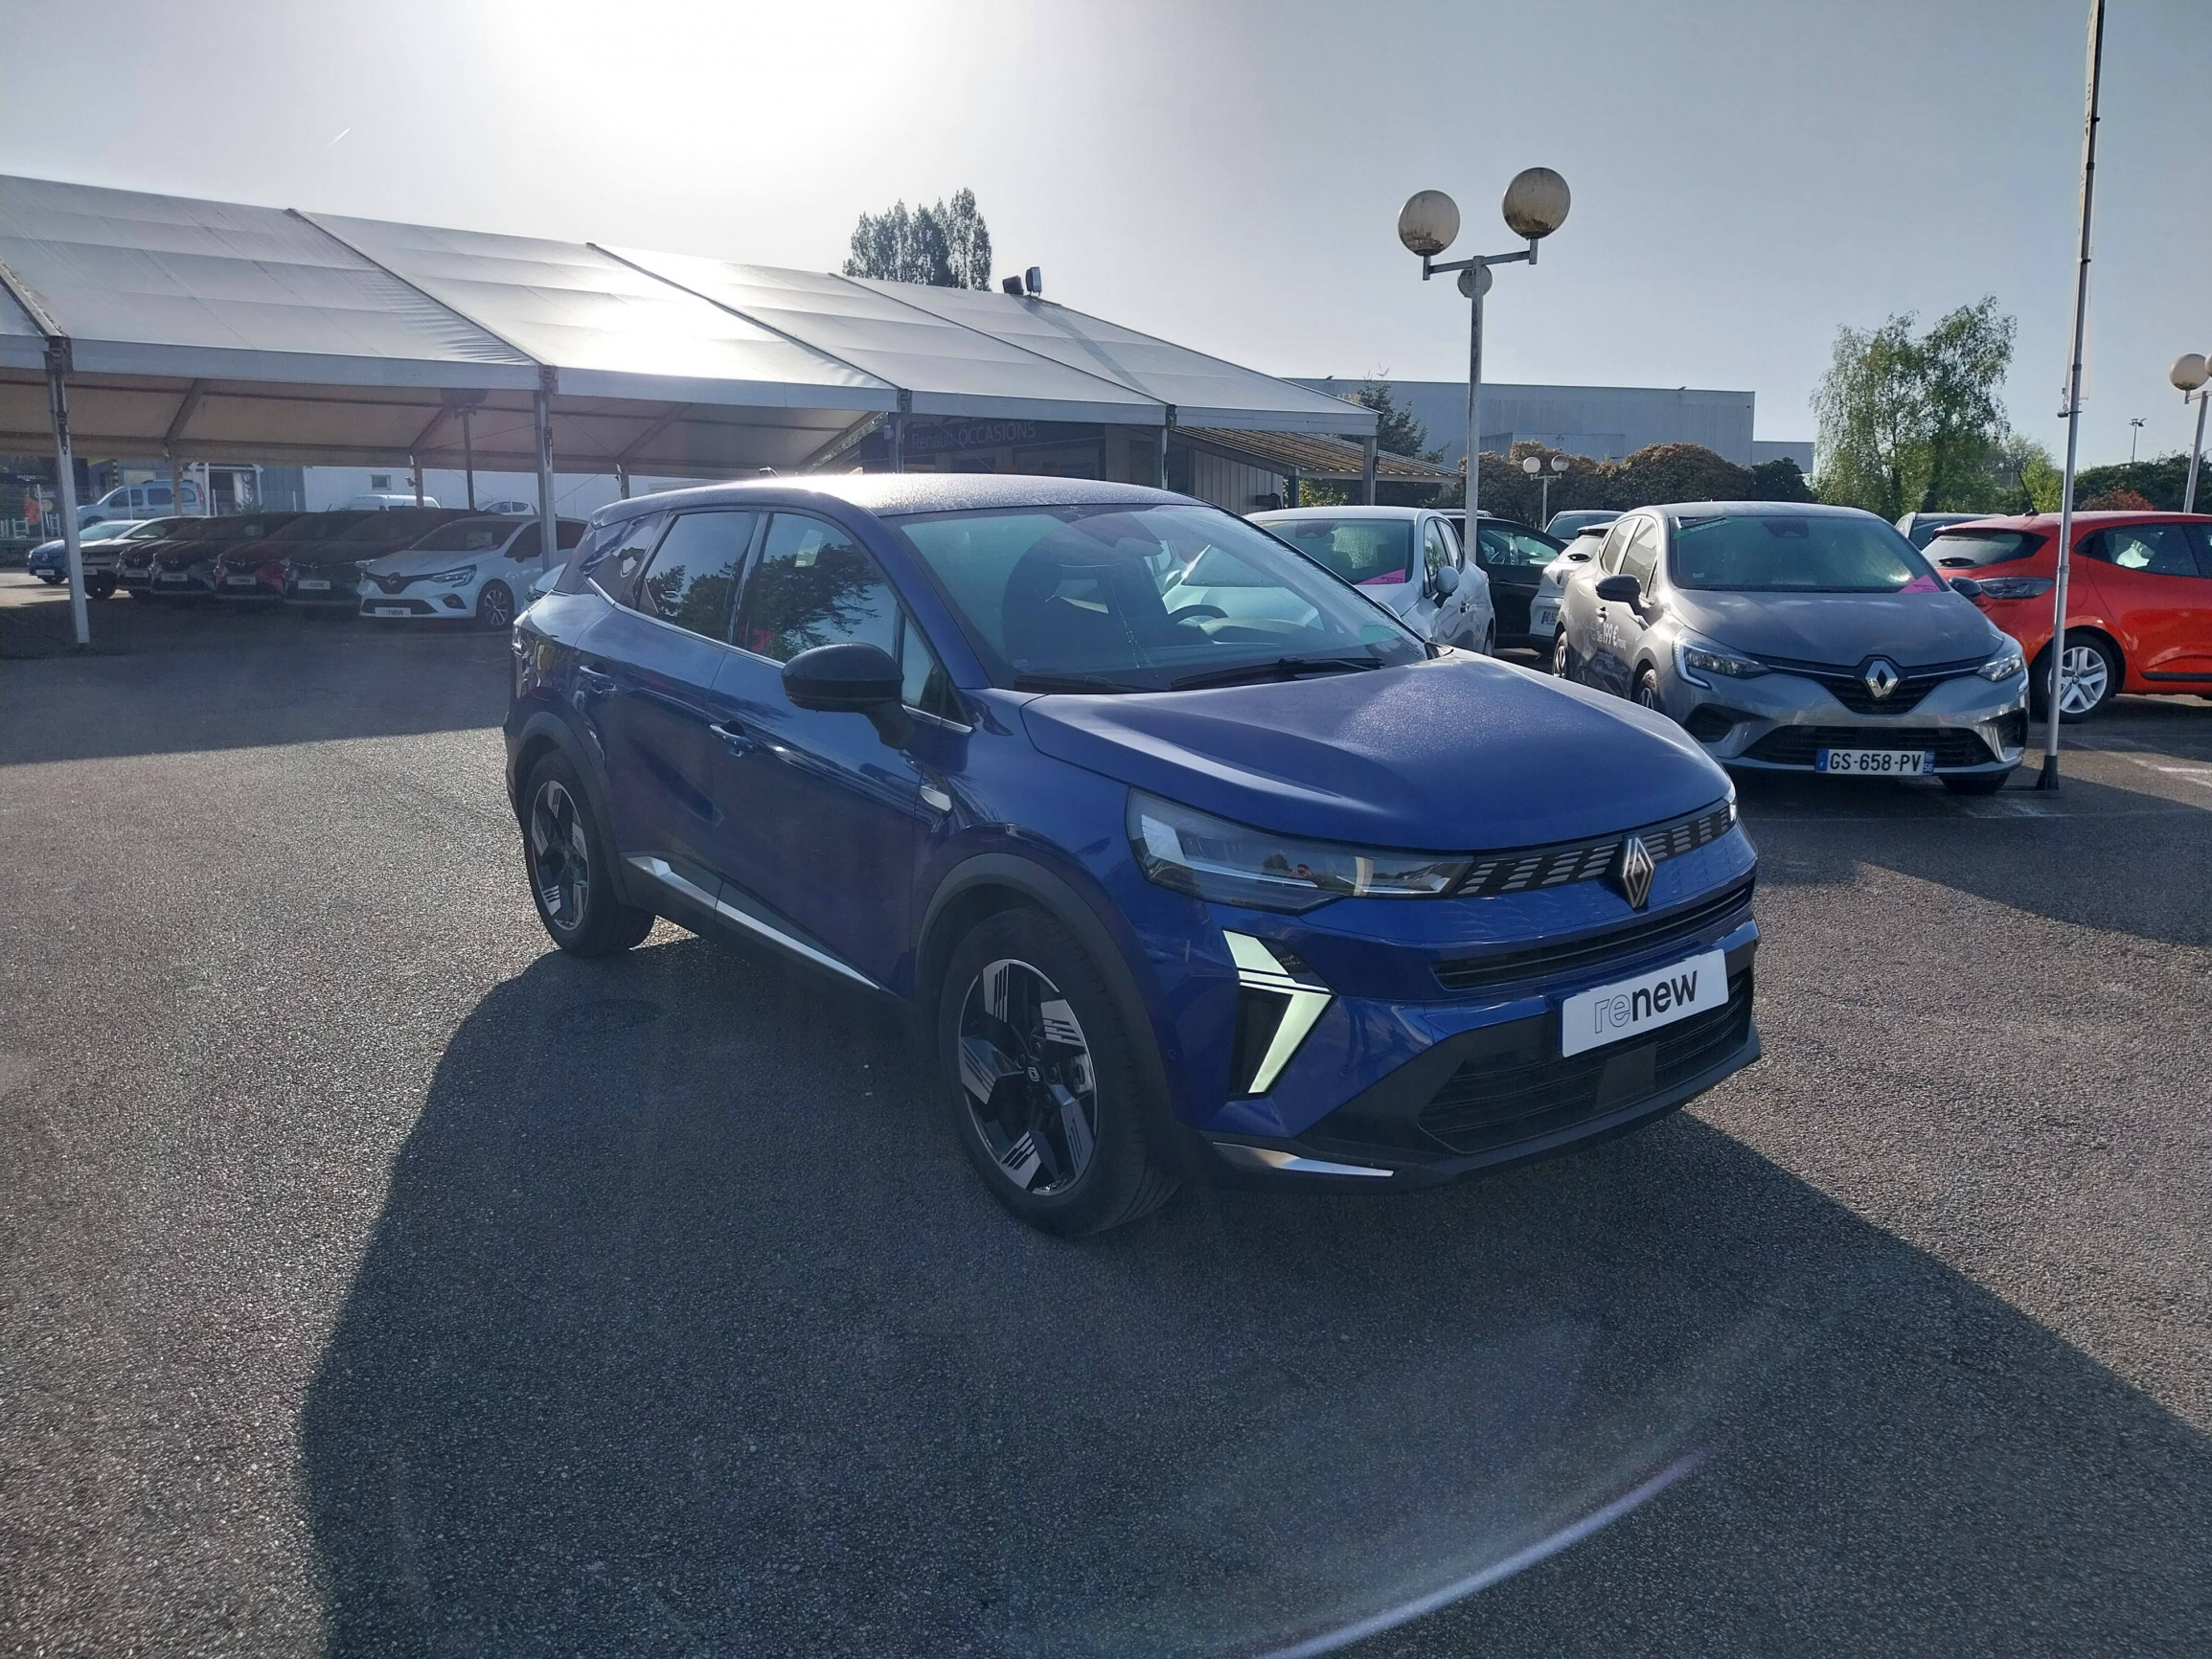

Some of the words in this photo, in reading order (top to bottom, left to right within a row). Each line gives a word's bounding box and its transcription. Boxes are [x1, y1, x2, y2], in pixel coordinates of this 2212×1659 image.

[912, 432, 953, 450] Renault
[958, 421, 1037, 445] OCCASIONS
[1830, 752, 1921, 772] GS-658-PV
[1594, 969, 1698, 1034] renew
